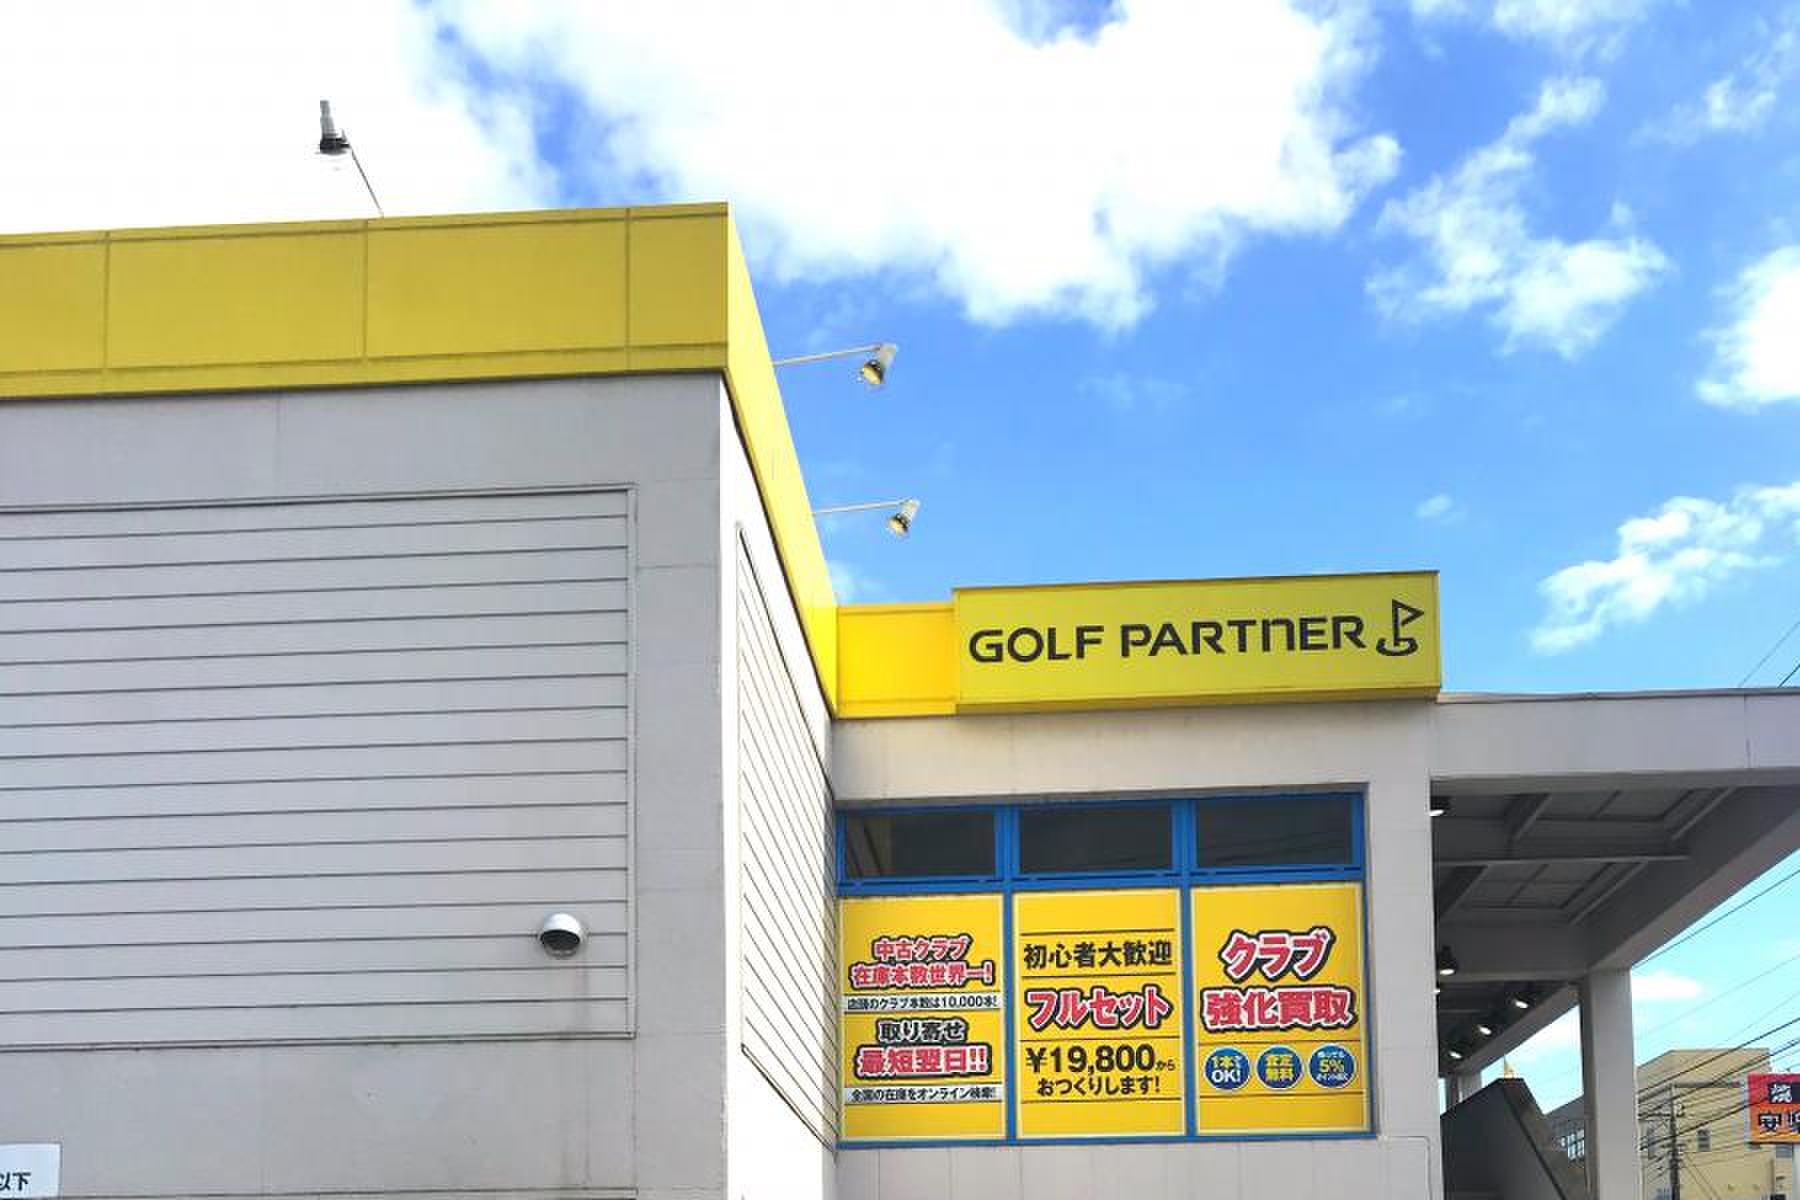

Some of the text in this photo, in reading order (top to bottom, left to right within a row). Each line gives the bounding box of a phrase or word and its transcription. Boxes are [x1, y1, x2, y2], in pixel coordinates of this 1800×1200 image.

[969, 615, 1367, 663] GOLF PARTNER
[872, 934, 973, 964] 中古クラブ
[1024, 940, 1172, 969] 初心者大歓迎
[1219, 927, 1335, 982] クラブ
[1026, 984, 1172, 1030] フルセット
[1202, 986, 1356, 1031] 強化買取
[878, 1020, 968, 1043] 取り寄せ
[856, 1046, 991, 1078] 最短翌日!!
[1211, 1069, 1241, 1083] OK!
[1037, 1075, 1161, 1096] おつくりします!
